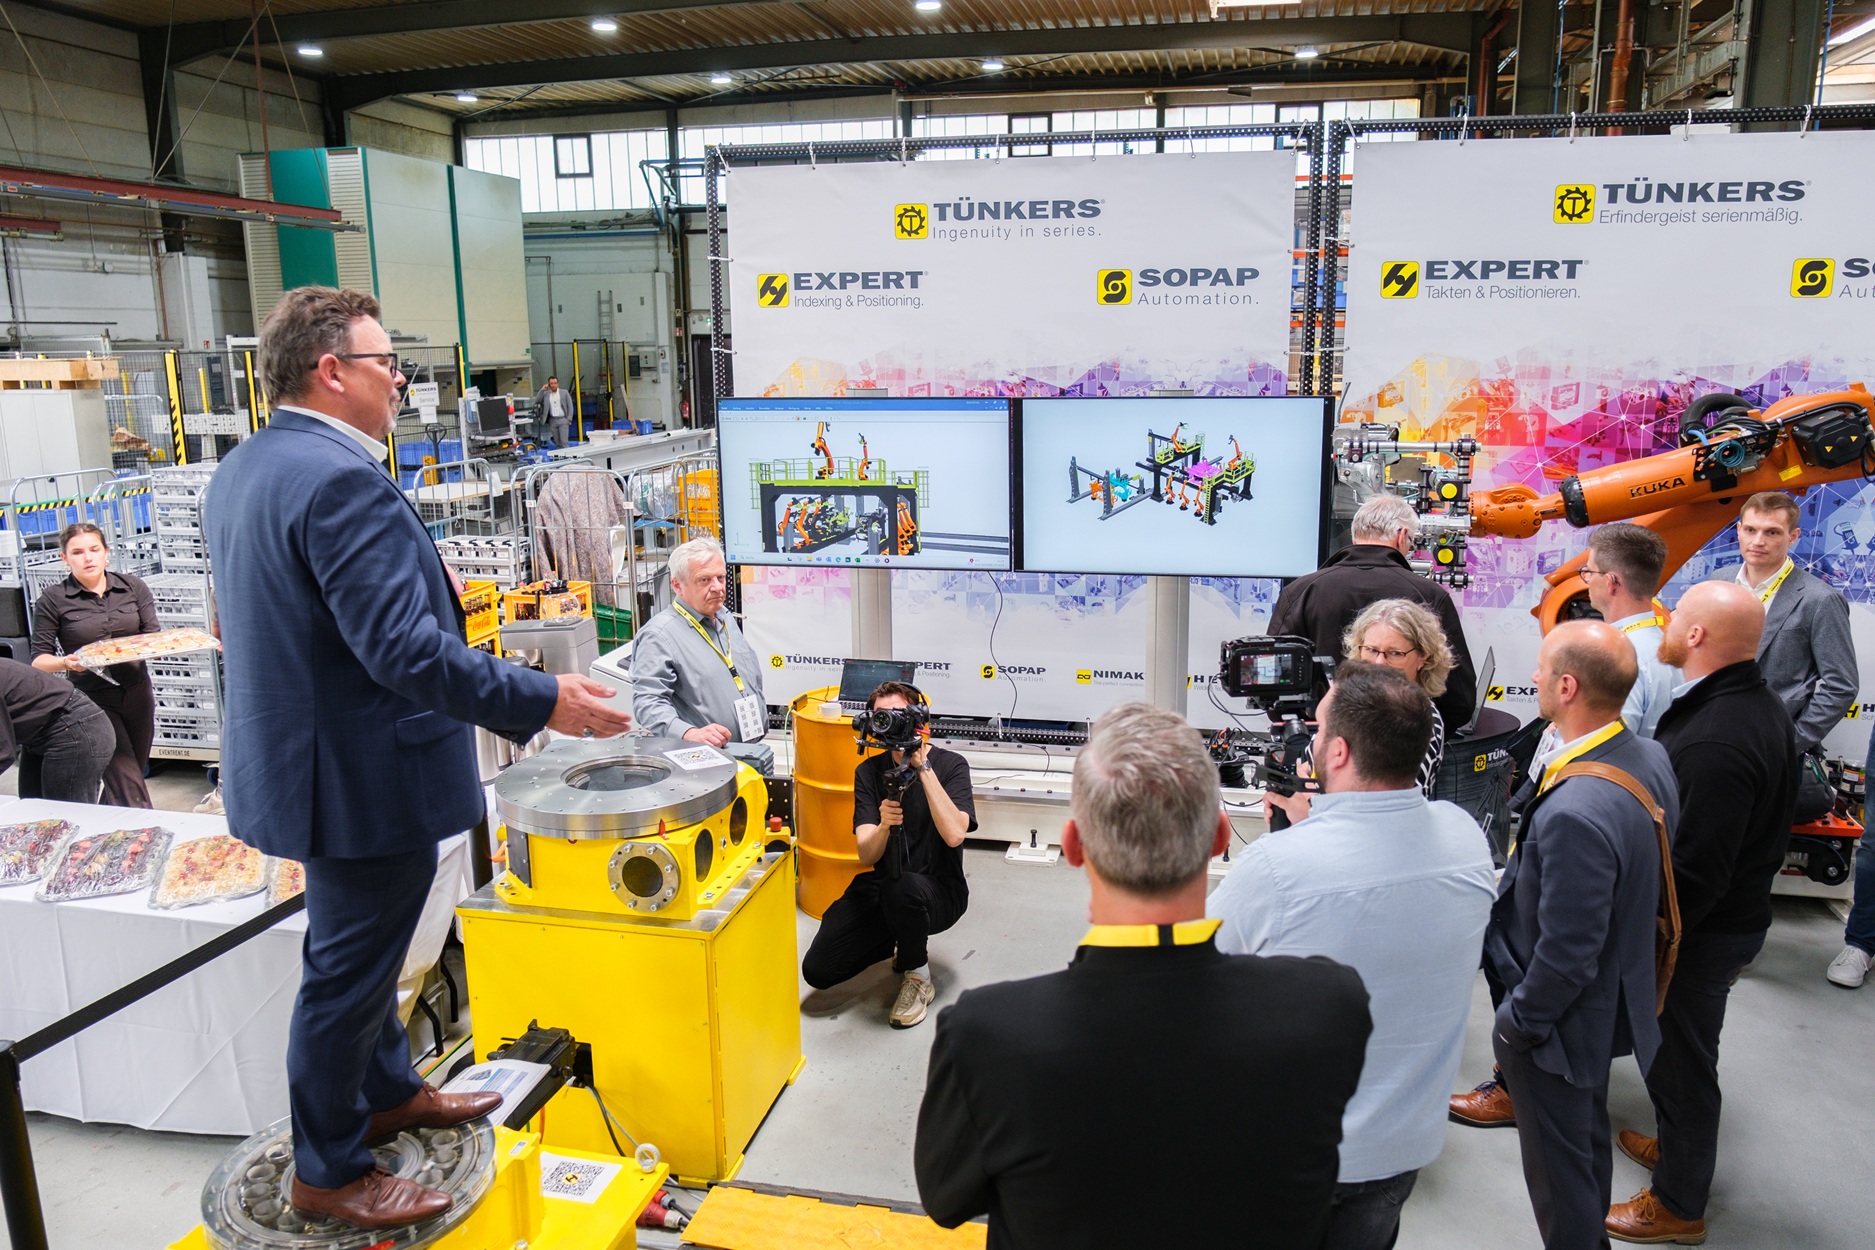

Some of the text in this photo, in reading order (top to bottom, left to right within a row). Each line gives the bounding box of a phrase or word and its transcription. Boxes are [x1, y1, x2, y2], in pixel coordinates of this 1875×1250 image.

[1602, 177, 1806, 204] TÜNKERS
[933, 197, 1102, 221] TÜNKERS
[1599, 207, 1803, 226] Erfindergeist serienmäßig.
[933, 225, 1102, 242] Ingenuity in series.
[1425, 259, 1584, 280] EXPERT
[1842, 257, 1875, 278] S
[793, 271, 923, 290] EXPERT
[1138, 267, 1260, 287] SOPAP
[1137, 292, 1260, 306] Automation.
[1425, 285, 1581, 299] Takten & Positionieren.
[794, 294, 924, 310] Indexing & Positioning.
[1630, 477, 1686, 498] KUKA
[785, 664, 816, 672] Ingenuity
[915, 661, 951, 670] PERT
[997, 665, 1047, 675] SOPAP
[997, 674, 1047, 683] Auomation.
[1093, 670, 1145, 680] NIMAK
